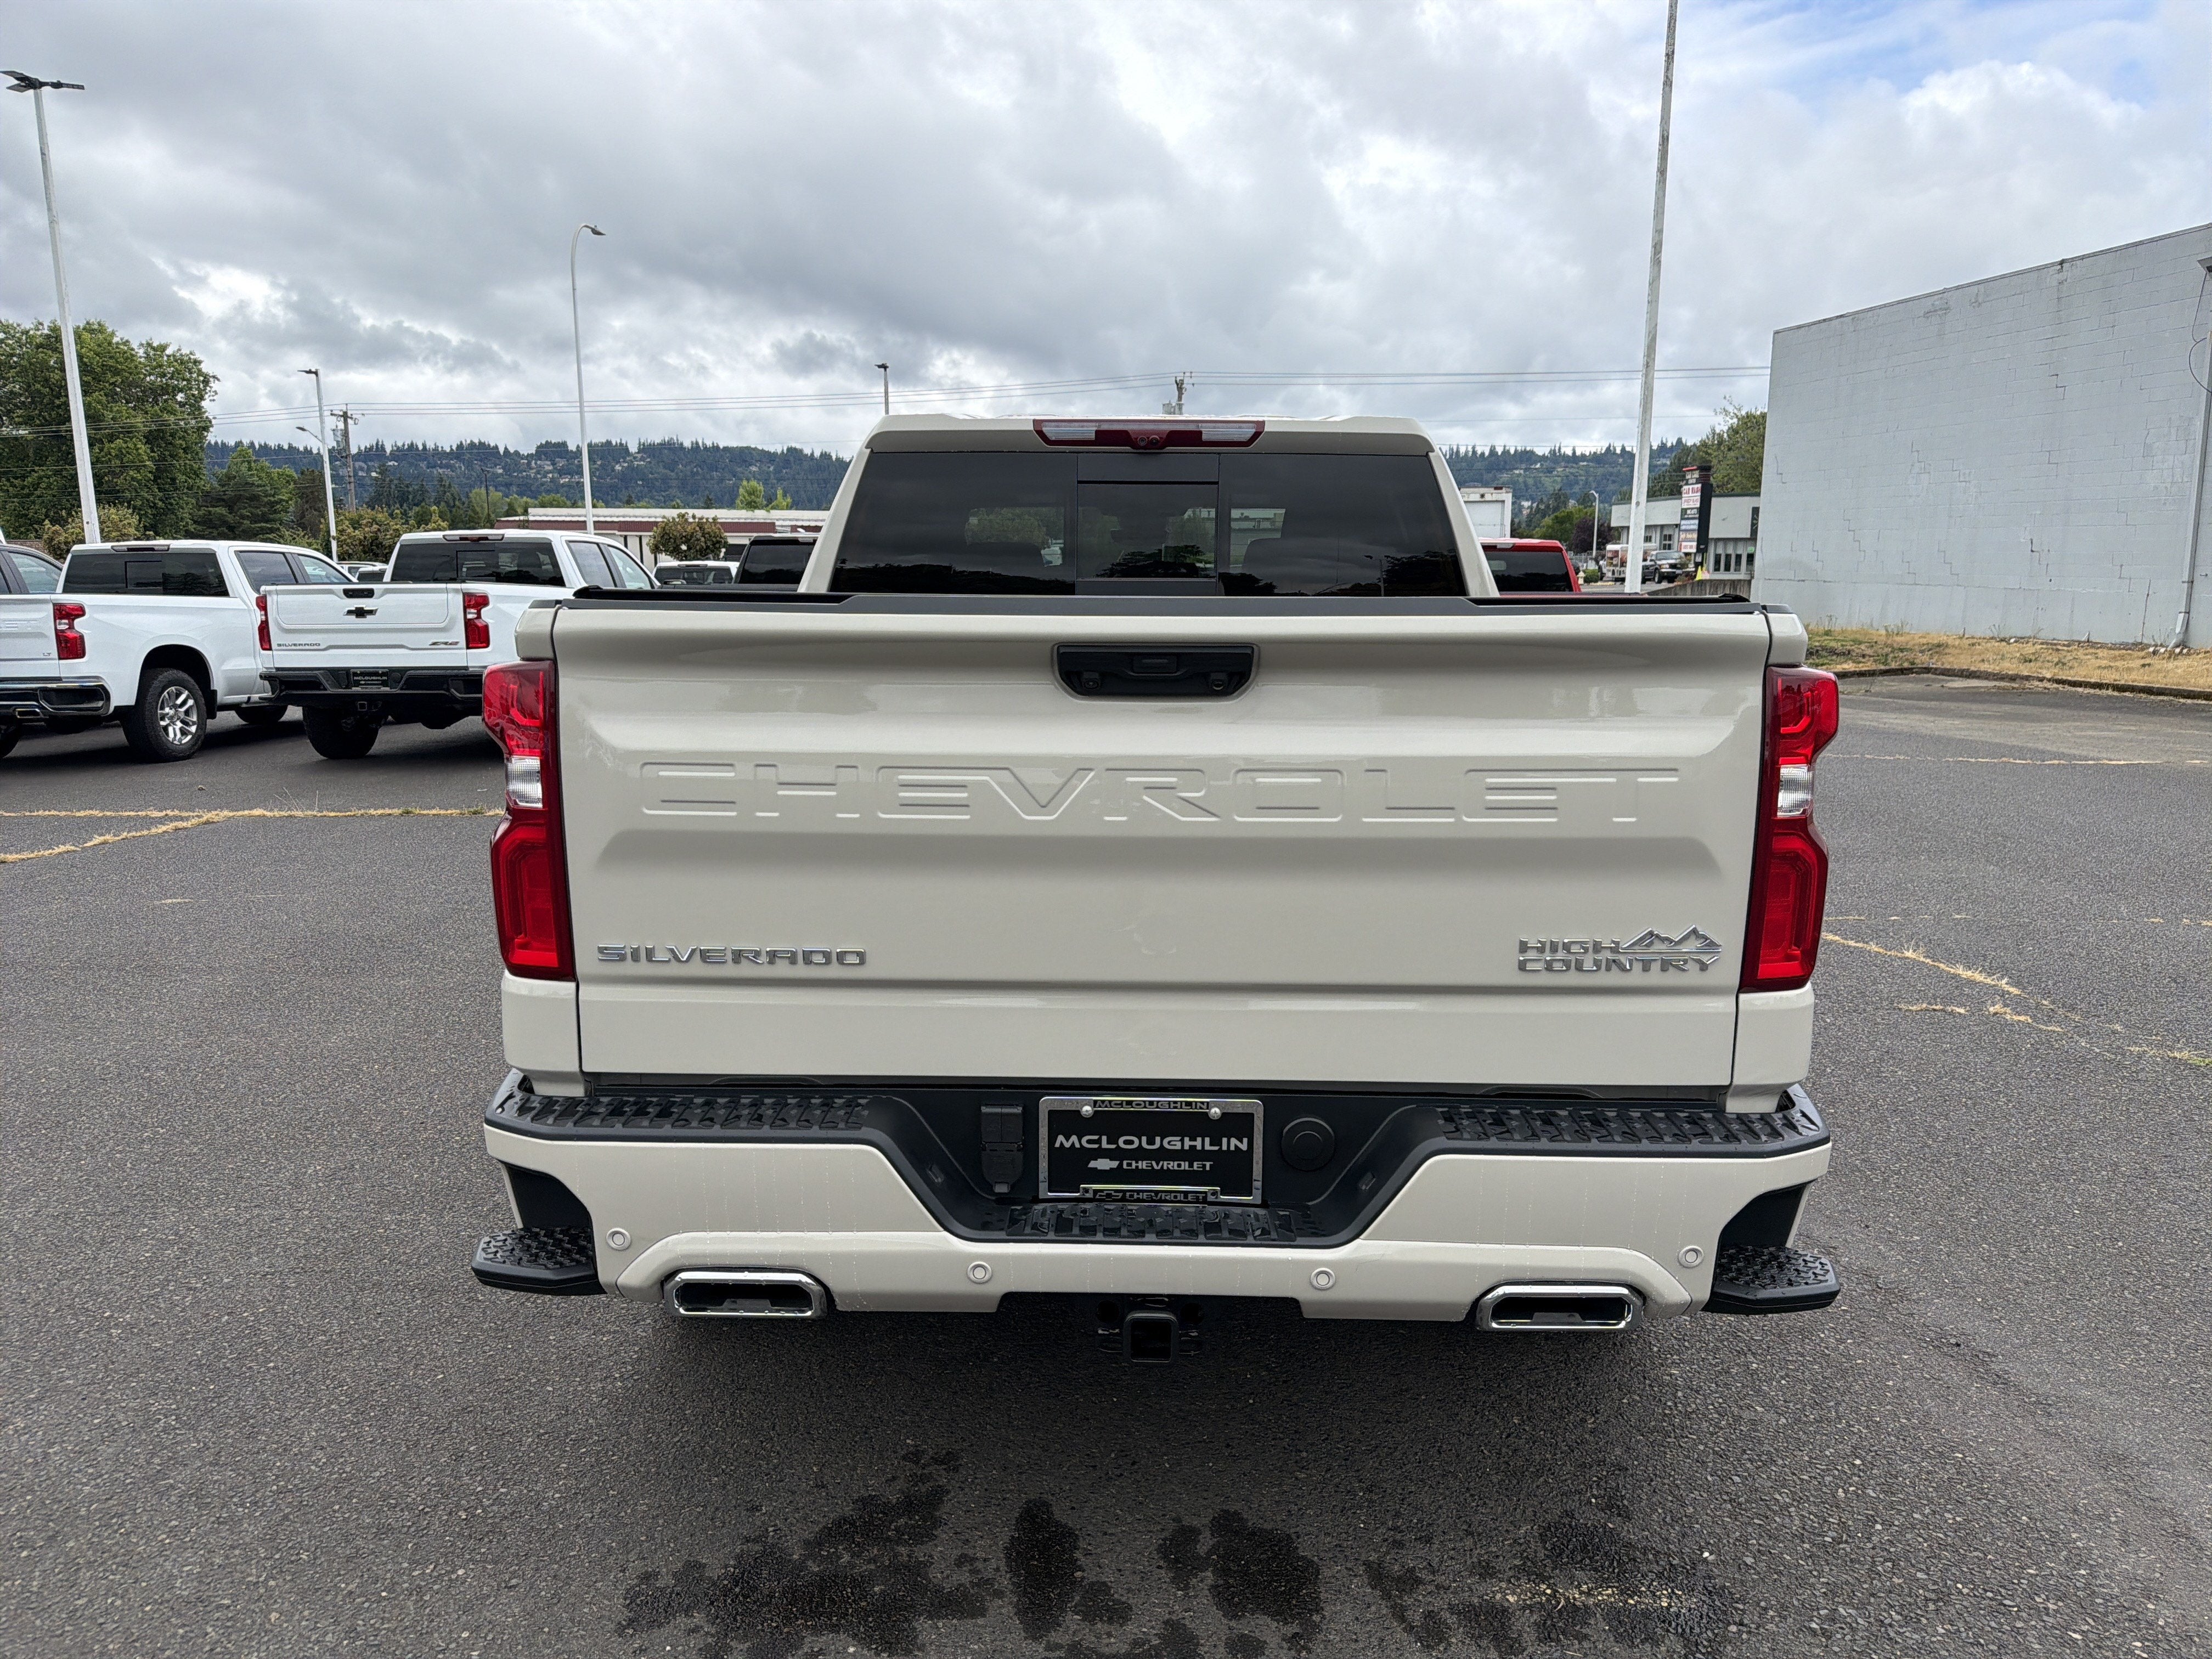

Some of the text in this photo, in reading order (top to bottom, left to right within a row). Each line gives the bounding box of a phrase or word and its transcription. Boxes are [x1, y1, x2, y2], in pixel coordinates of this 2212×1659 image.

[640, 761, 1679, 822] CHEVROLET
[1518, 937, 1622, 954] HIGH
[597, 943, 867, 966] SILVERADO
[1517, 955, 1720, 972] COUNTRY
[1095, 1100, 1207, 1110] MCLOUGHLIN
[1053, 1134, 1249, 1152] MCLOUGHLIN
[1122, 1160, 1214, 1171] CHEVROLET
[1125, 1192, 1206, 1203] CHEVROLET
